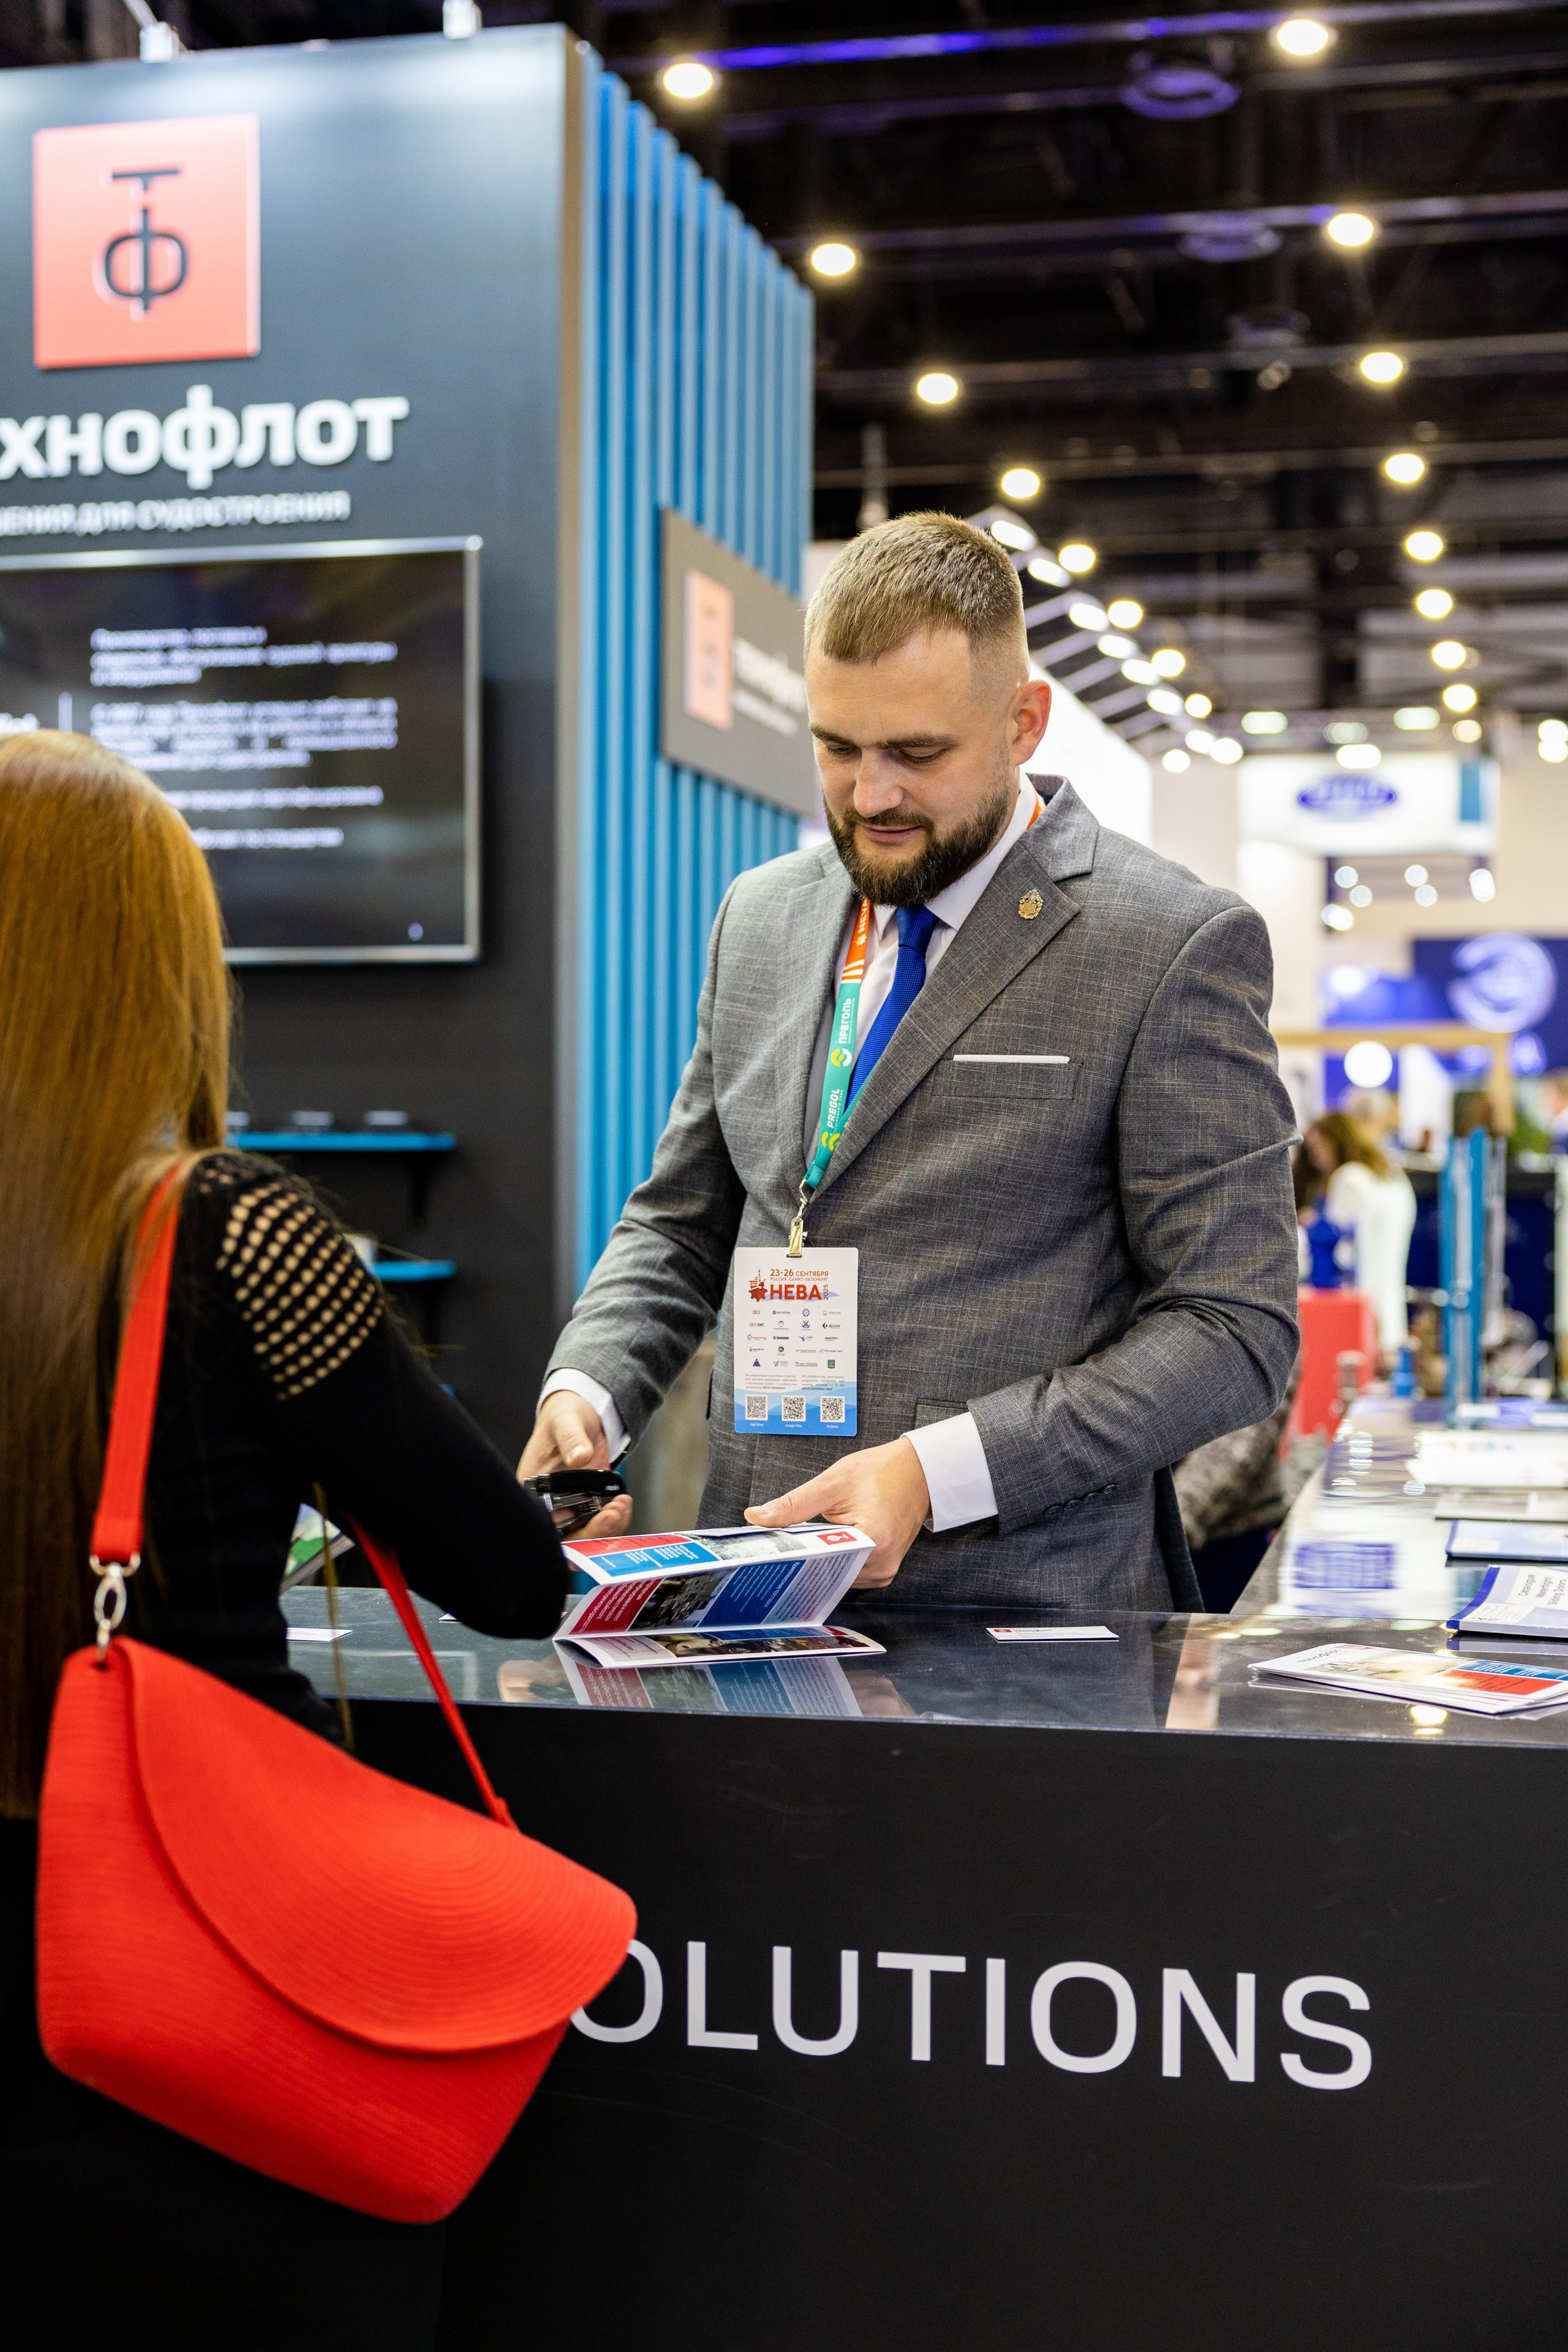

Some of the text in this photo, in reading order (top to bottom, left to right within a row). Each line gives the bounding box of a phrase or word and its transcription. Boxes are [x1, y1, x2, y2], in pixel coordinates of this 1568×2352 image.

[0, 385, 409, 490] хнофлот
[858, 897, 867, 933] NEVA
[827, 1088, 840, 1128] PREGOL
[770, 1284, 822, 1300] НЕВА
[570, 1938, 1372, 2090] OLUTIONS
